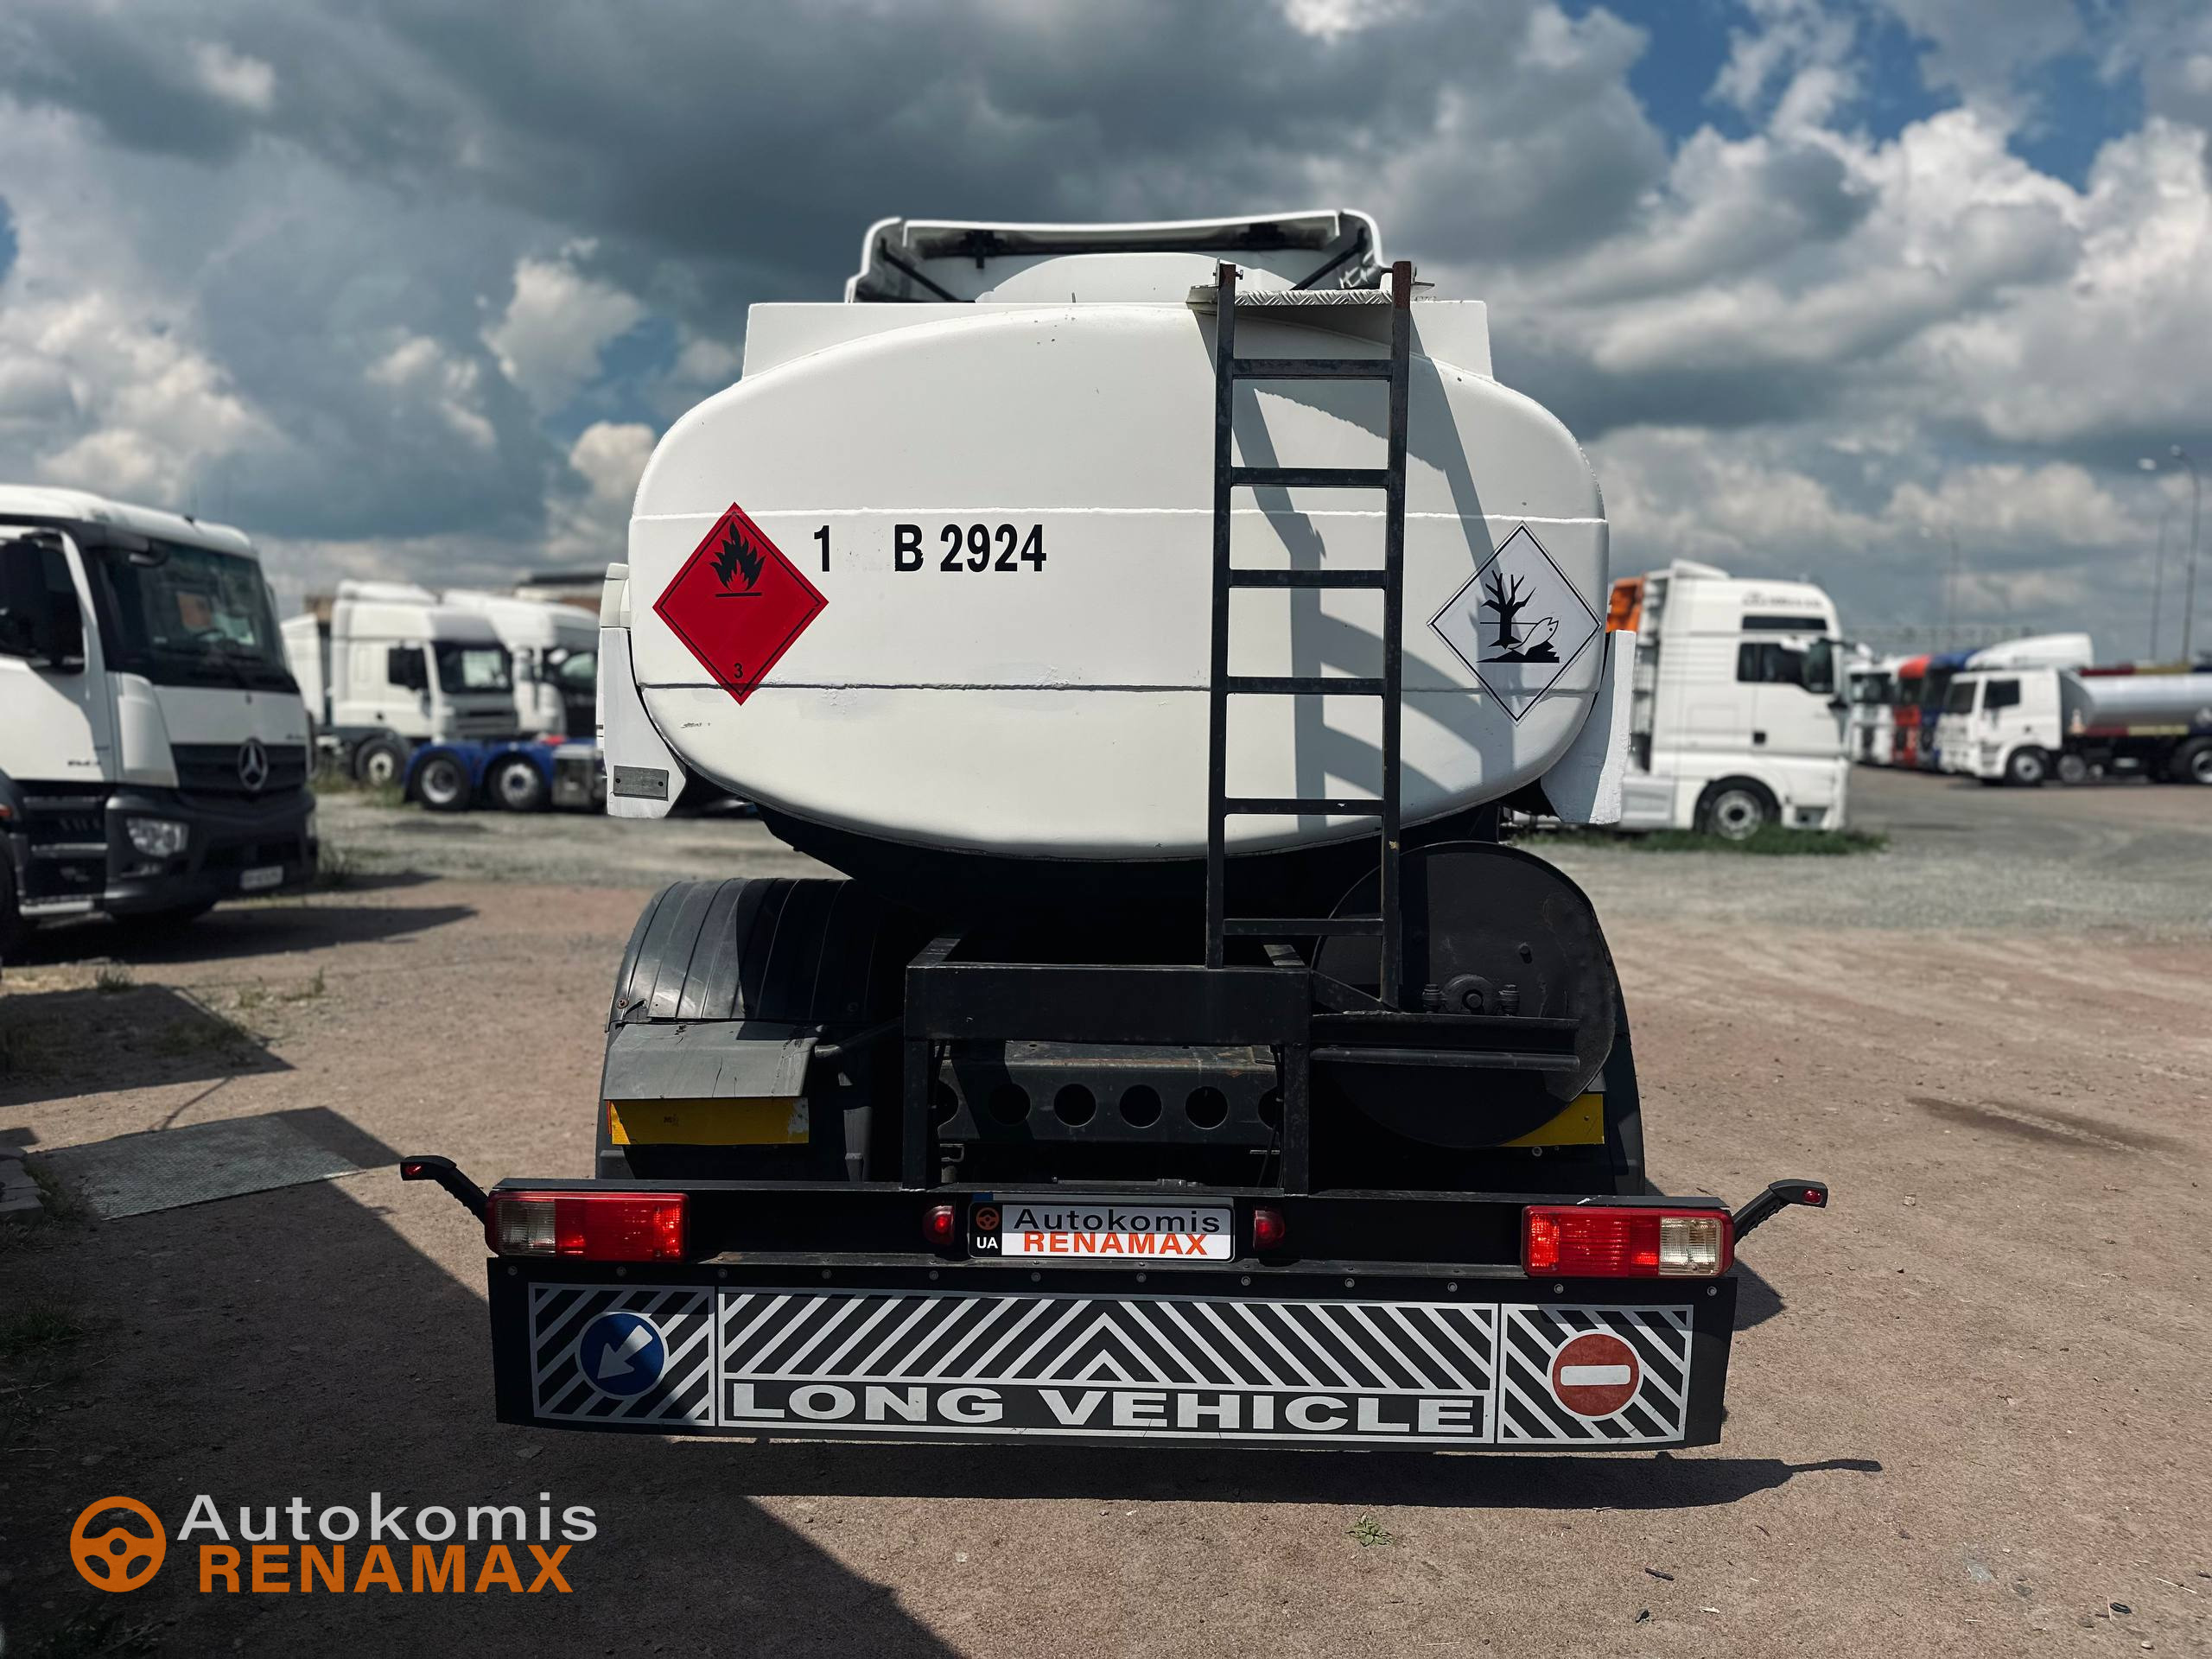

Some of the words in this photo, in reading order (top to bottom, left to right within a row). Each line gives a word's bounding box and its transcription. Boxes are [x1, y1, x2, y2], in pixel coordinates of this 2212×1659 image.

[813, 524, 830, 572] 1
[894, 524, 925, 572] B
[940, 523, 1047, 573] 2924
[733, 662, 744, 679] 3
[1014, 1208, 1220, 1233] Autokomis
[976, 1236, 999, 1249] UA
[1024, 1230, 1208, 1255] RENAMAX
[733, 1382, 1003, 1424] LONG
[1038, 1389, 1474, 1434] VEHICLE
